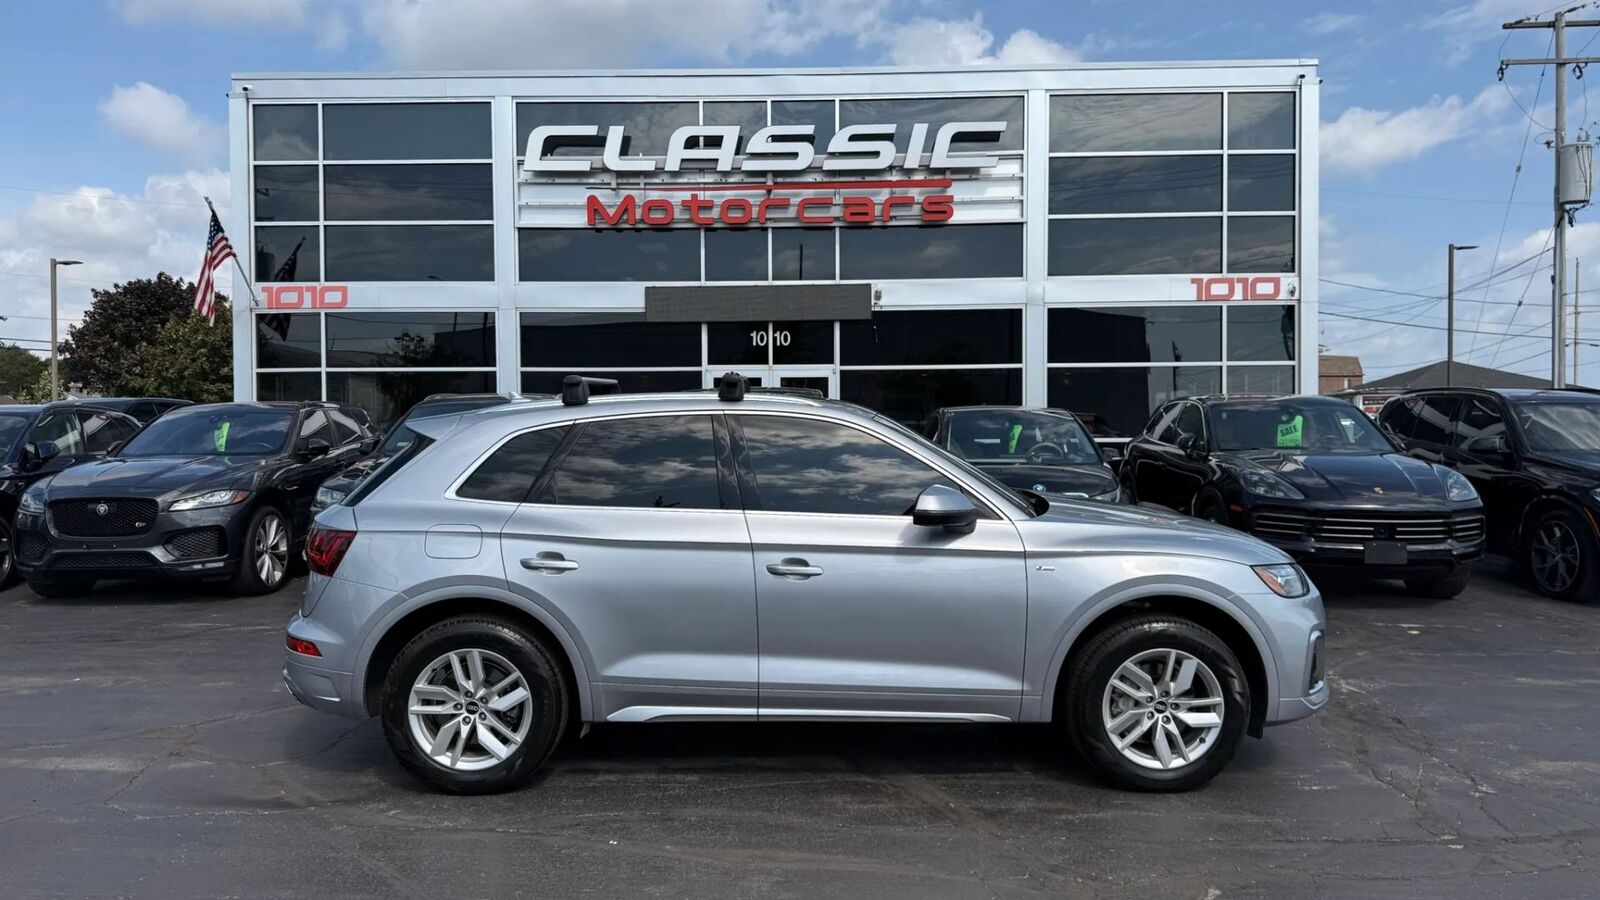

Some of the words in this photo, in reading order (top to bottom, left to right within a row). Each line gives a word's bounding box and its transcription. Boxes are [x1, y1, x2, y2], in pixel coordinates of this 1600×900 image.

[523, 122, 1008, 172] CLASSIC
[586, 193, 954, 226] Motorcars
[261, 285, 348, 309] 1010
[1190, 276, 1281, 301] 1010
[1279, 424, 1298, 437] SALE
